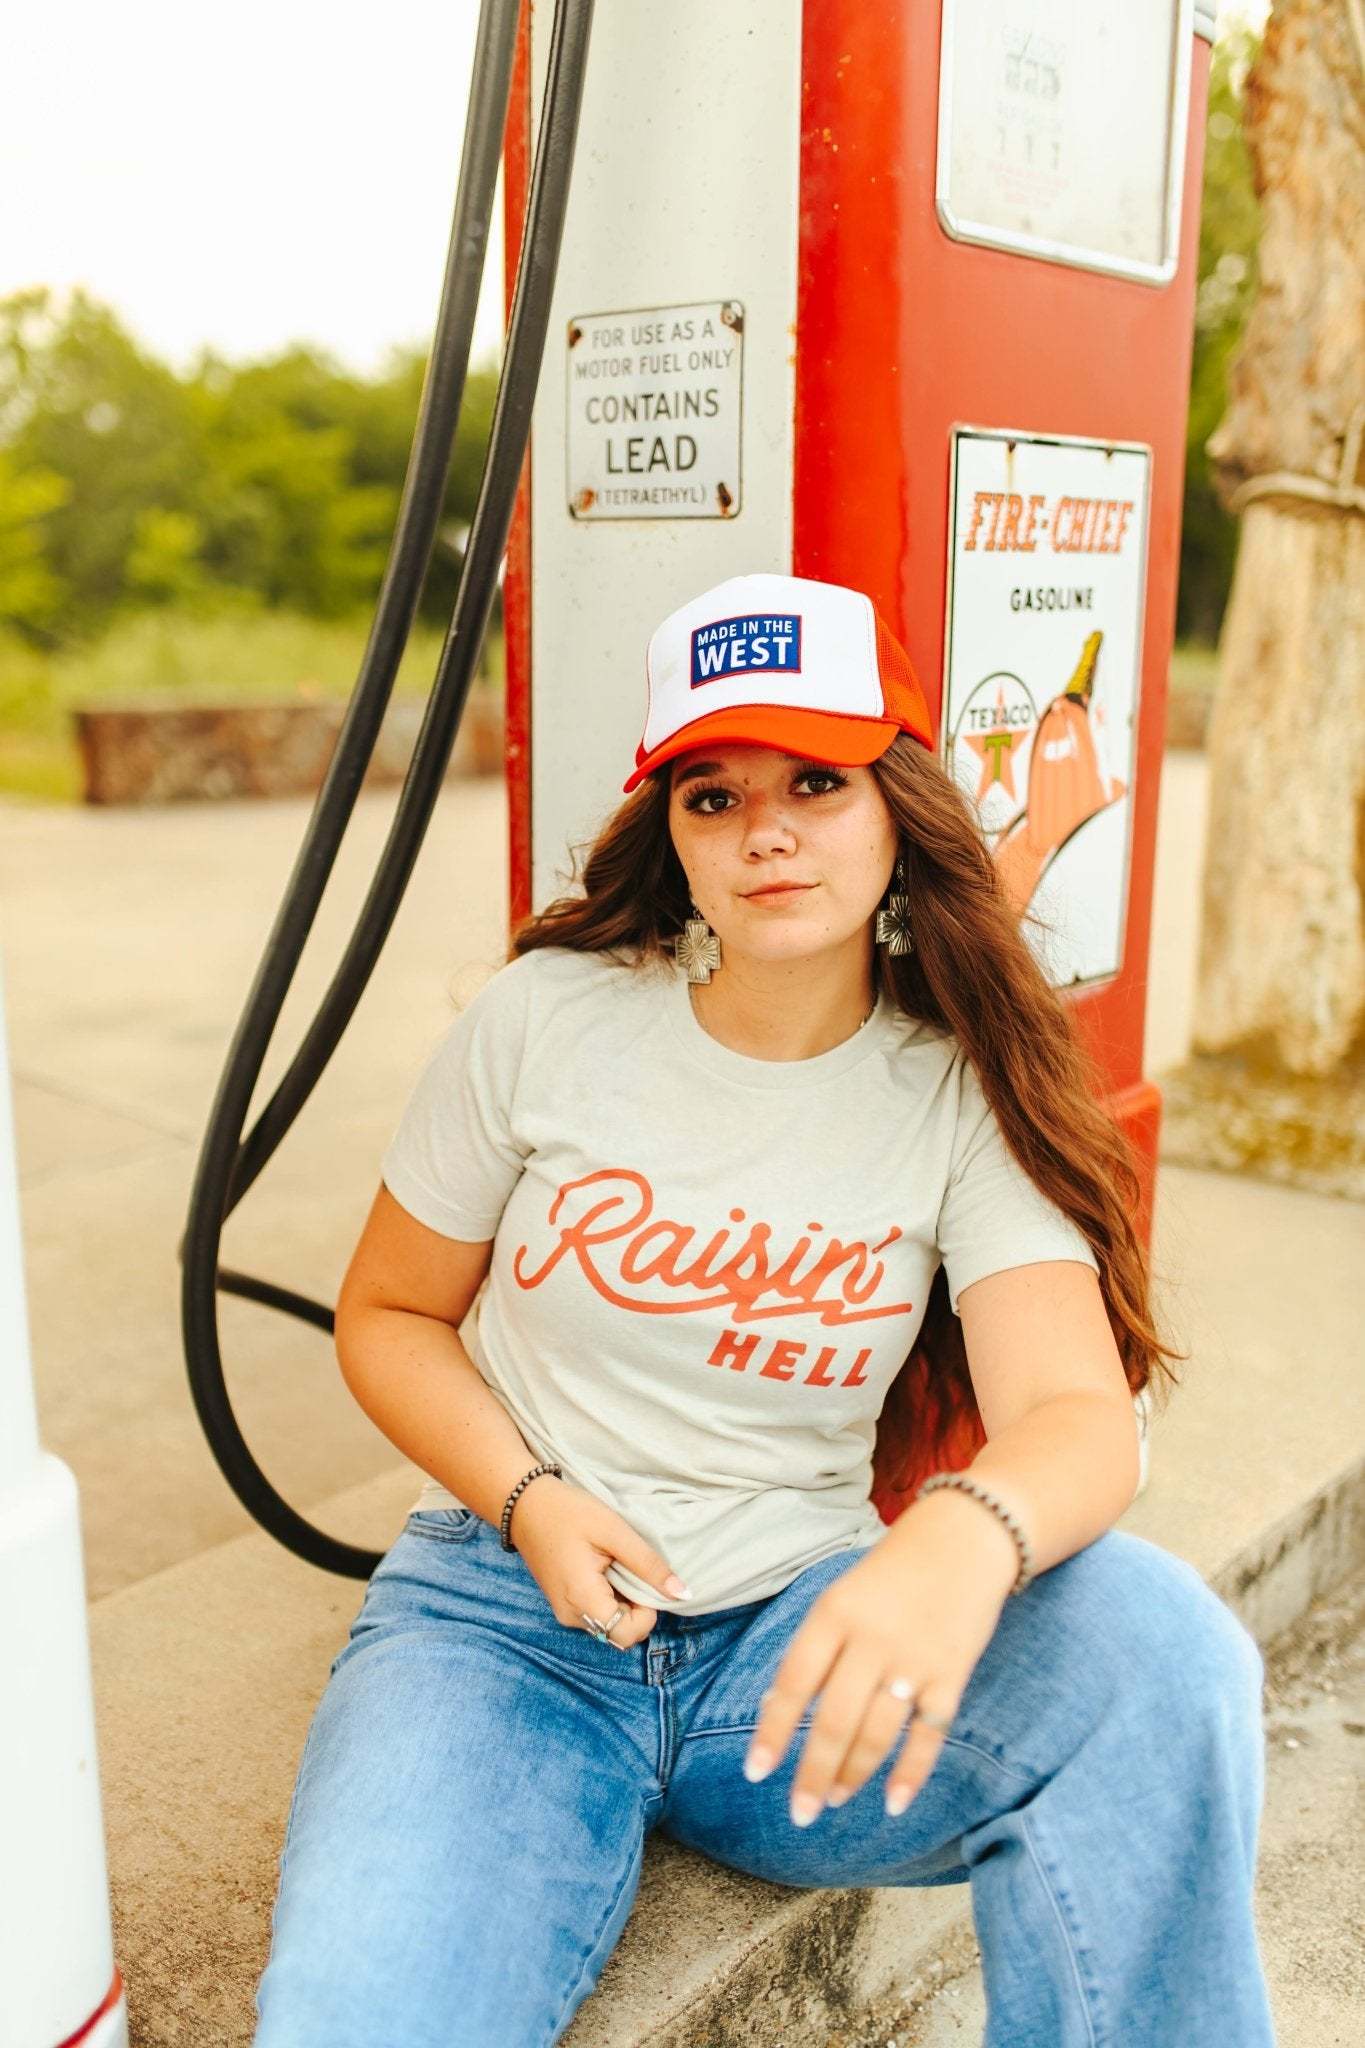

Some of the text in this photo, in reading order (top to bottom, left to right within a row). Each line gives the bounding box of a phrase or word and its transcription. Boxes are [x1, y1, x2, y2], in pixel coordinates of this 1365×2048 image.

[592, 318, 715, 348] FOR USE AS A
[575, 349, 734, 379] MOTOR FUEL ONLY
[586, 389, 720, 424] CONTAINS
[606, 435, 698, 474] LEAD
[1010, 587, 1092, 612] GASOLINE
[697, 620, 793, 647] MADE IN THE
[697, 636, 793, 677] WEST
[969, 704, 1031, 729] TEXACO
[706, 1329, 873, 1388] HELL
